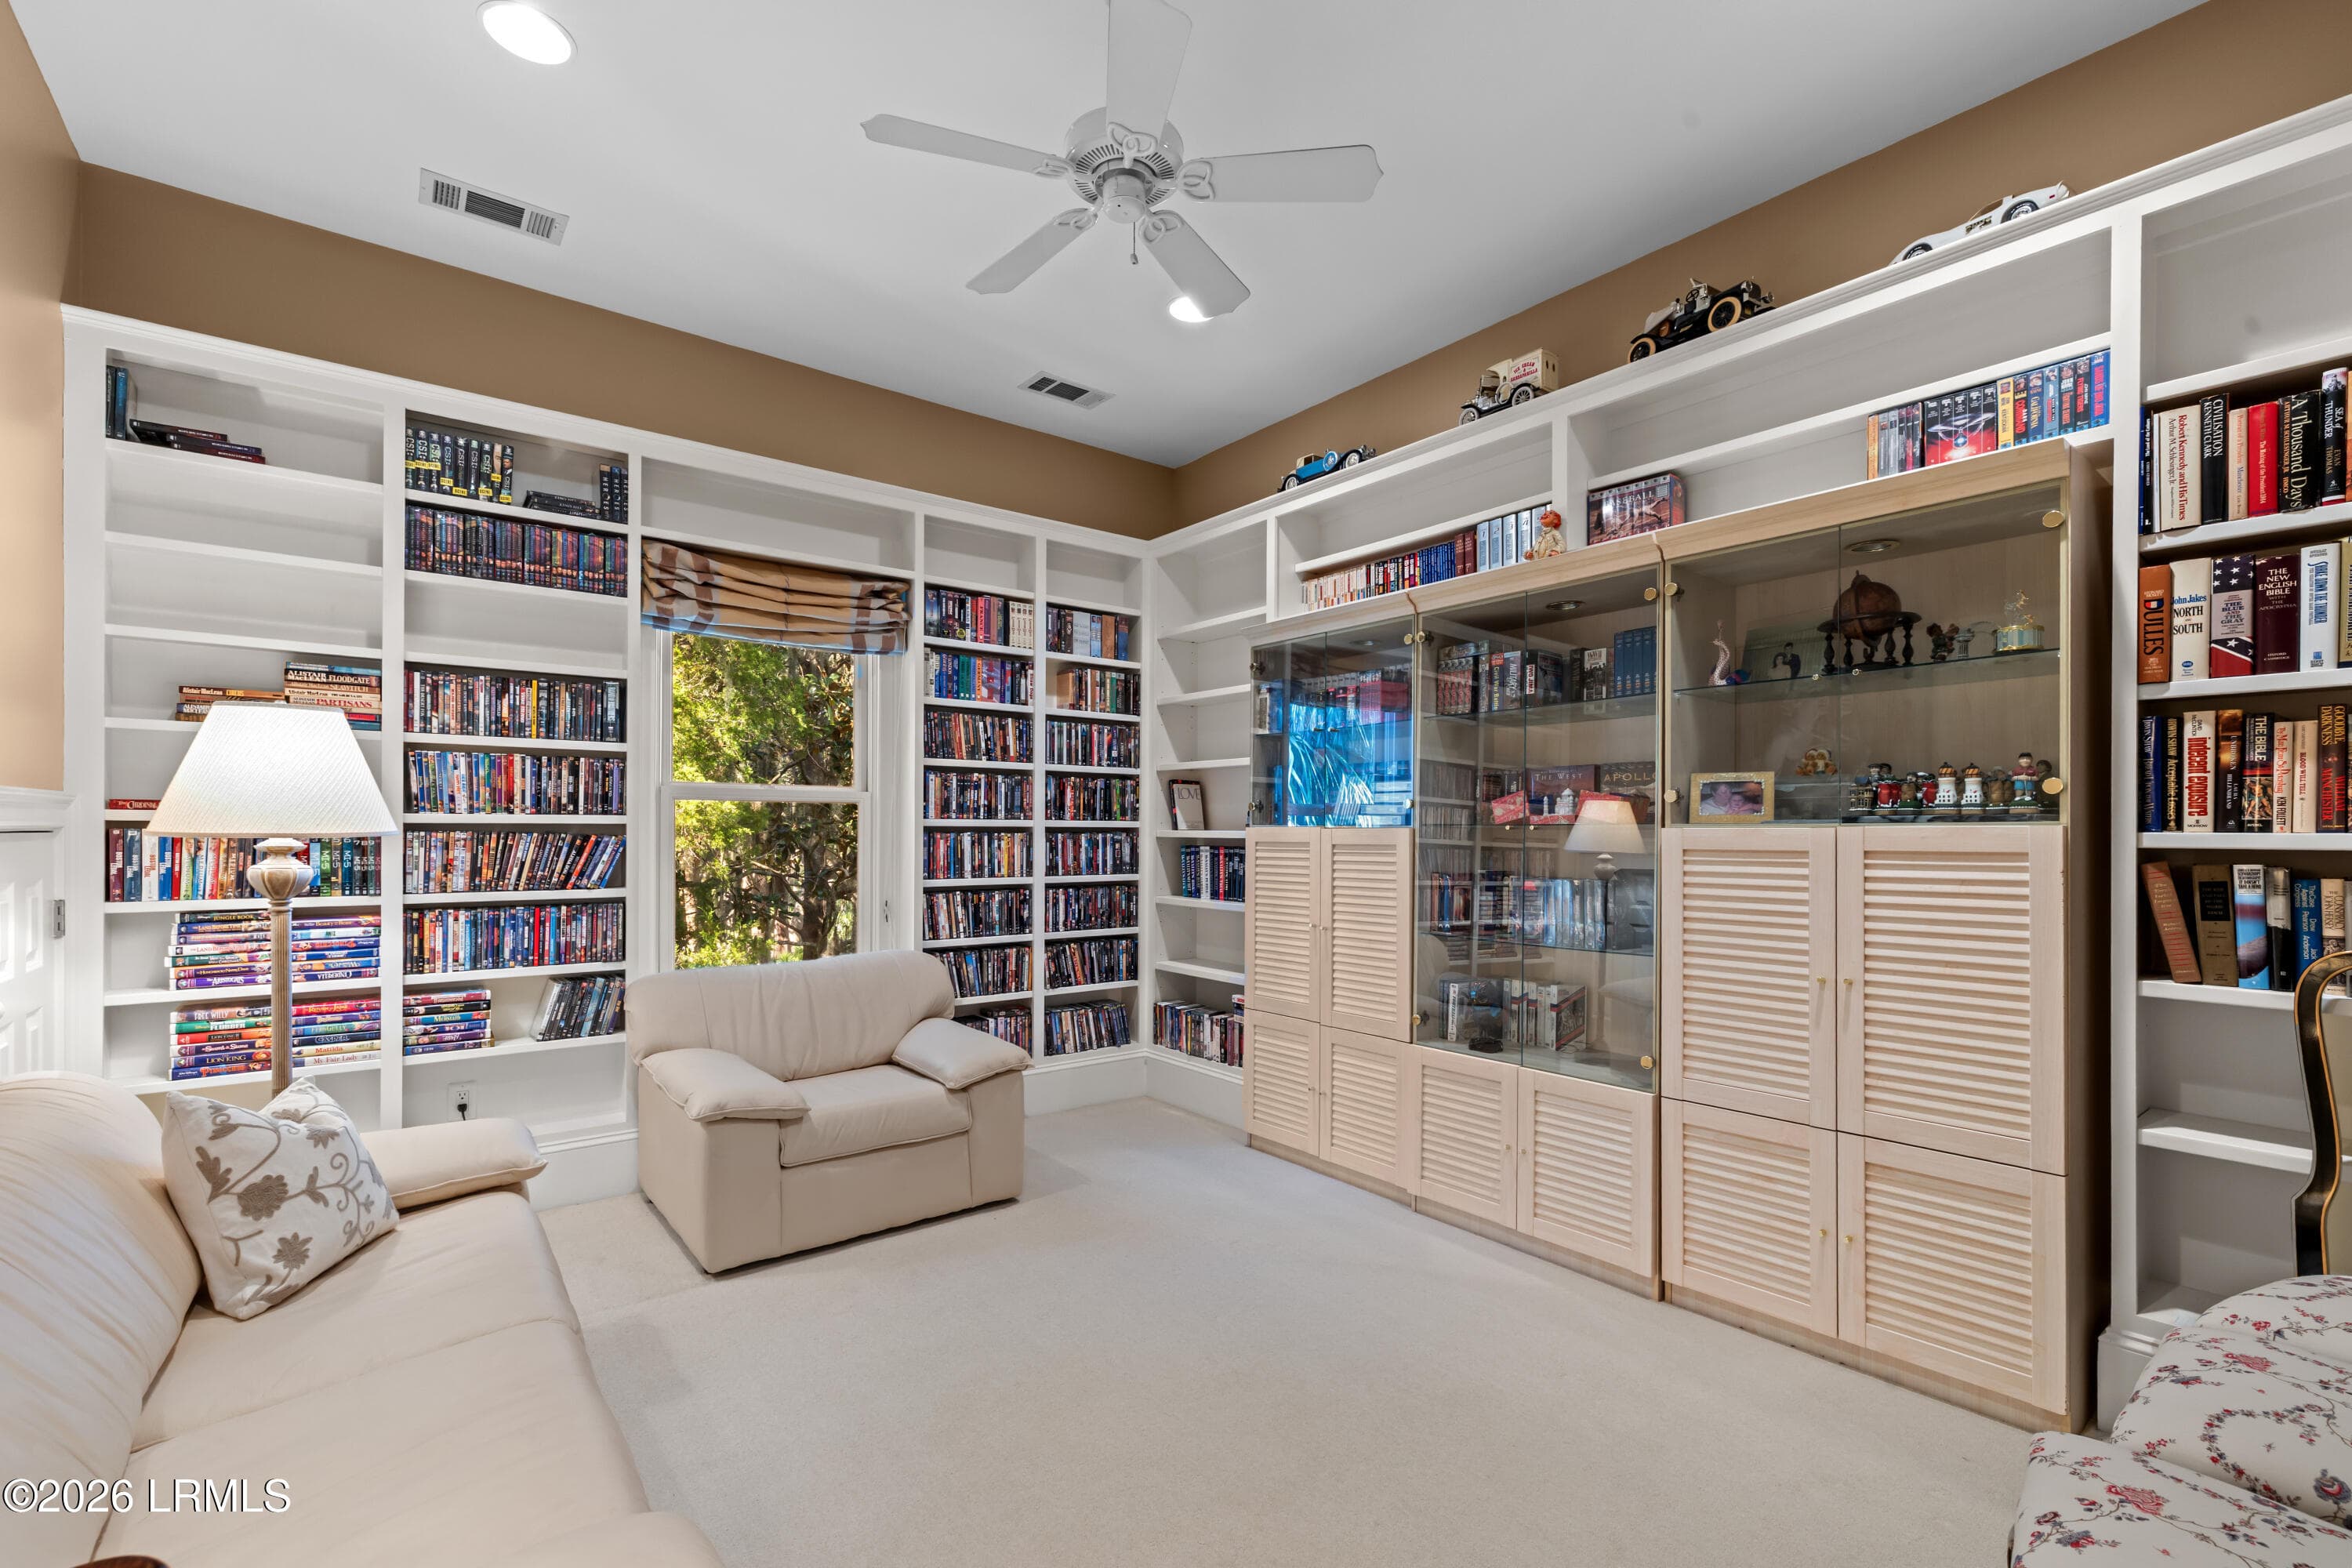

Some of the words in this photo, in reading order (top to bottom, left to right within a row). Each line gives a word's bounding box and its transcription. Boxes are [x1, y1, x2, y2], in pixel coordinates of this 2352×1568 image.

[2292, 398, 2308, 409] A
[2016, 400, 2024, 433] COMMAND
[2031, 397, 2040, 430] CALIFORNIA
[2324, 401, 2333, 439] THUNDER
[2335, 408, 2344, 420] SEA
[2169, 418, 2177, 437] Arthur
[2179, 415, 2187, 439] Robert
[2213, 399, 2223, 456] CIVILISATION
[2291, 411, 2311, 473] Thousand
[431, 444, 440, 461] CSI:
[2177, 440, 2187, 470] Kennedy
[2179, 472, 2187, 486] and
[2179, 487, 2187, 498] His
[2285, 476, 2307, 508] Days
[2179, 498, 2187, 521] Times
[2259, 580, 2297, 590] ENGLISH
[2266, 574, 2291, 583] NEW
[2172, 596, 2187, 605] John
[2187, 594, 2206, 604] Jakes
[2173, 605, 2203, 618] NORTH
[2143, 598, 2164, 655] DULLES
[2172, 623, 2203, 635] SOUTH
[329, 674, 370, 684] FLOODGATE
[329, 684, 368, 692] SEAWITCH
[316, 699, 372, 709] PARTISANS
[2143, 720, 2153, 735] IRWIN
[2168, 719, 2176, 737] IRWIN
[2255, 717, 2267, 734] THE
[2321, 706, 2333, 745] DARKNESS
[2143, 736, 2153, 753] SHAW
[2168, 739, 2176, 756] SHAW
[2255, 736, 2267, 760] BIBLE
[2187, 737, 2211, 773] indecent
[2165, 759, 2178, 797] Acceptable
[2185, 776, 2208, 817] exposure
[2277, 797, 2286, 805] KEN
[2321, 768, 2333, 820] MANCHESTER
[2336, 775, 2346, 811] WILLIAM
[2167, 798, 2178, 820] Losses
[2277, 806, 2286, 826] FOLLETT
[566, 850, 575, 864] ALPHA
[2334, 895, 2345, 931] CONSPIRACY
[317, 971, 353, 980] CINDERELLA
[194, 1012, 209, 1021] FREE
[211, 1011, 229, 1020] WILLY
